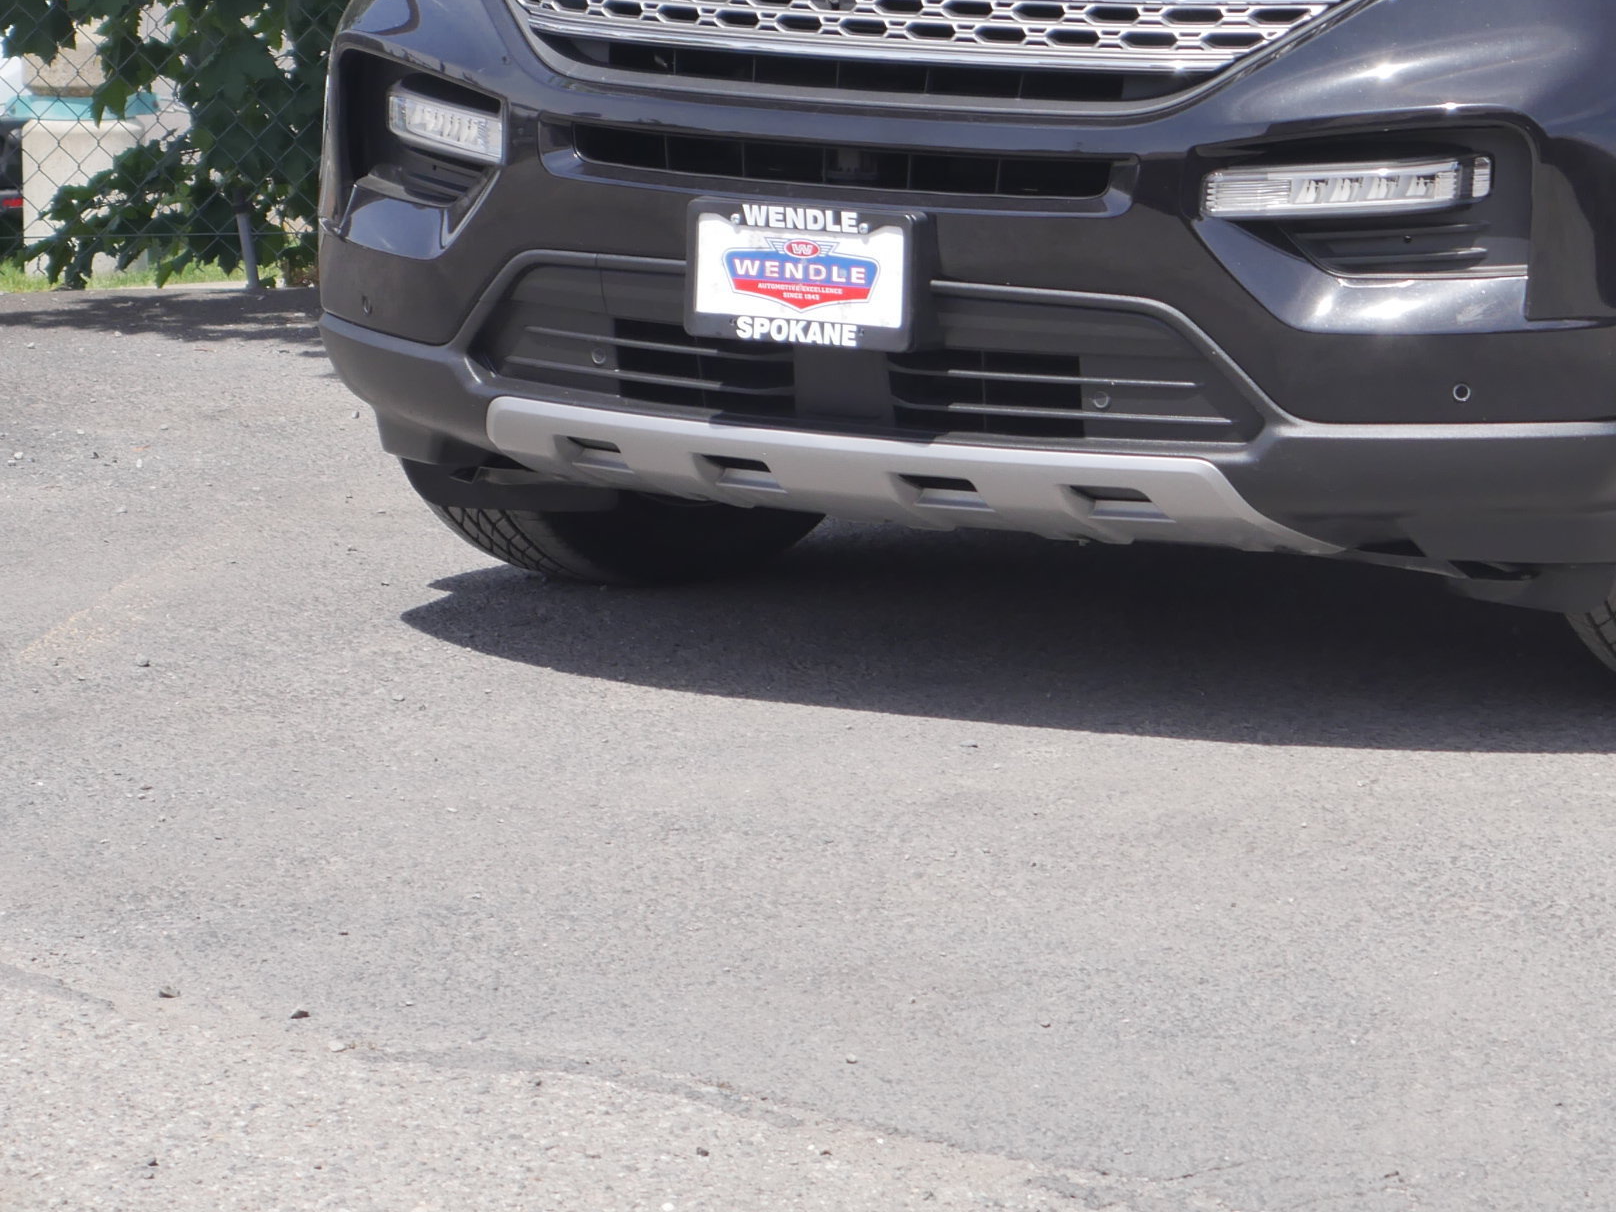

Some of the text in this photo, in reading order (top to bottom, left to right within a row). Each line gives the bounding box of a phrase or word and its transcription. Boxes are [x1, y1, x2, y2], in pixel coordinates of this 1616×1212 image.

[742, 204, 859, 234] WENDLE
[734, 258, 866, 284] WENDLE
[757, 282, 800, 292] AUTOMOTIVE
[736, 316, 857, 347] SPOKANE
